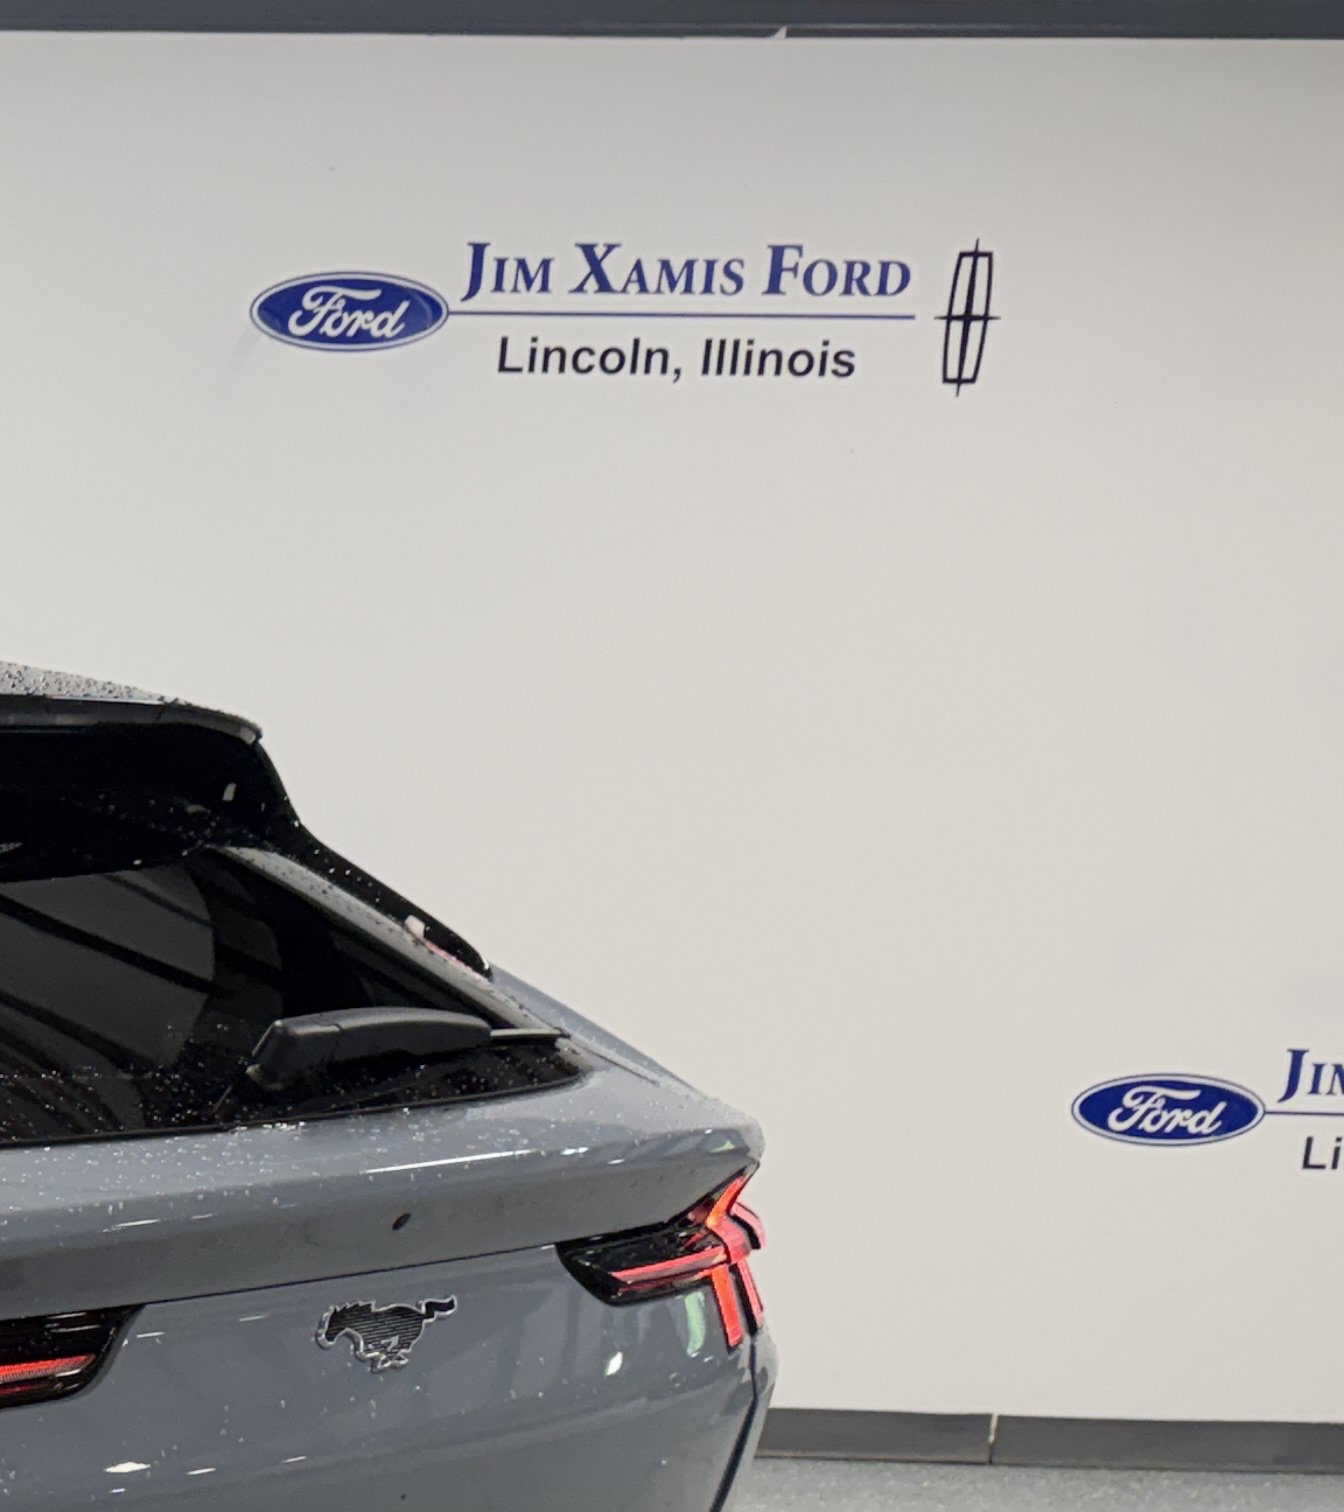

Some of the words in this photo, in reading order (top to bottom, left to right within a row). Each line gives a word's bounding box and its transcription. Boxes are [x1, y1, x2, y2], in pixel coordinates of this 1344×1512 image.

[288, 286, 410, 338] Ford
[497, 337, 682, 382] Lincoln,
[701, 338, 857, 378] Illinois
[1108, 1086, 1227, 1134] Ford
